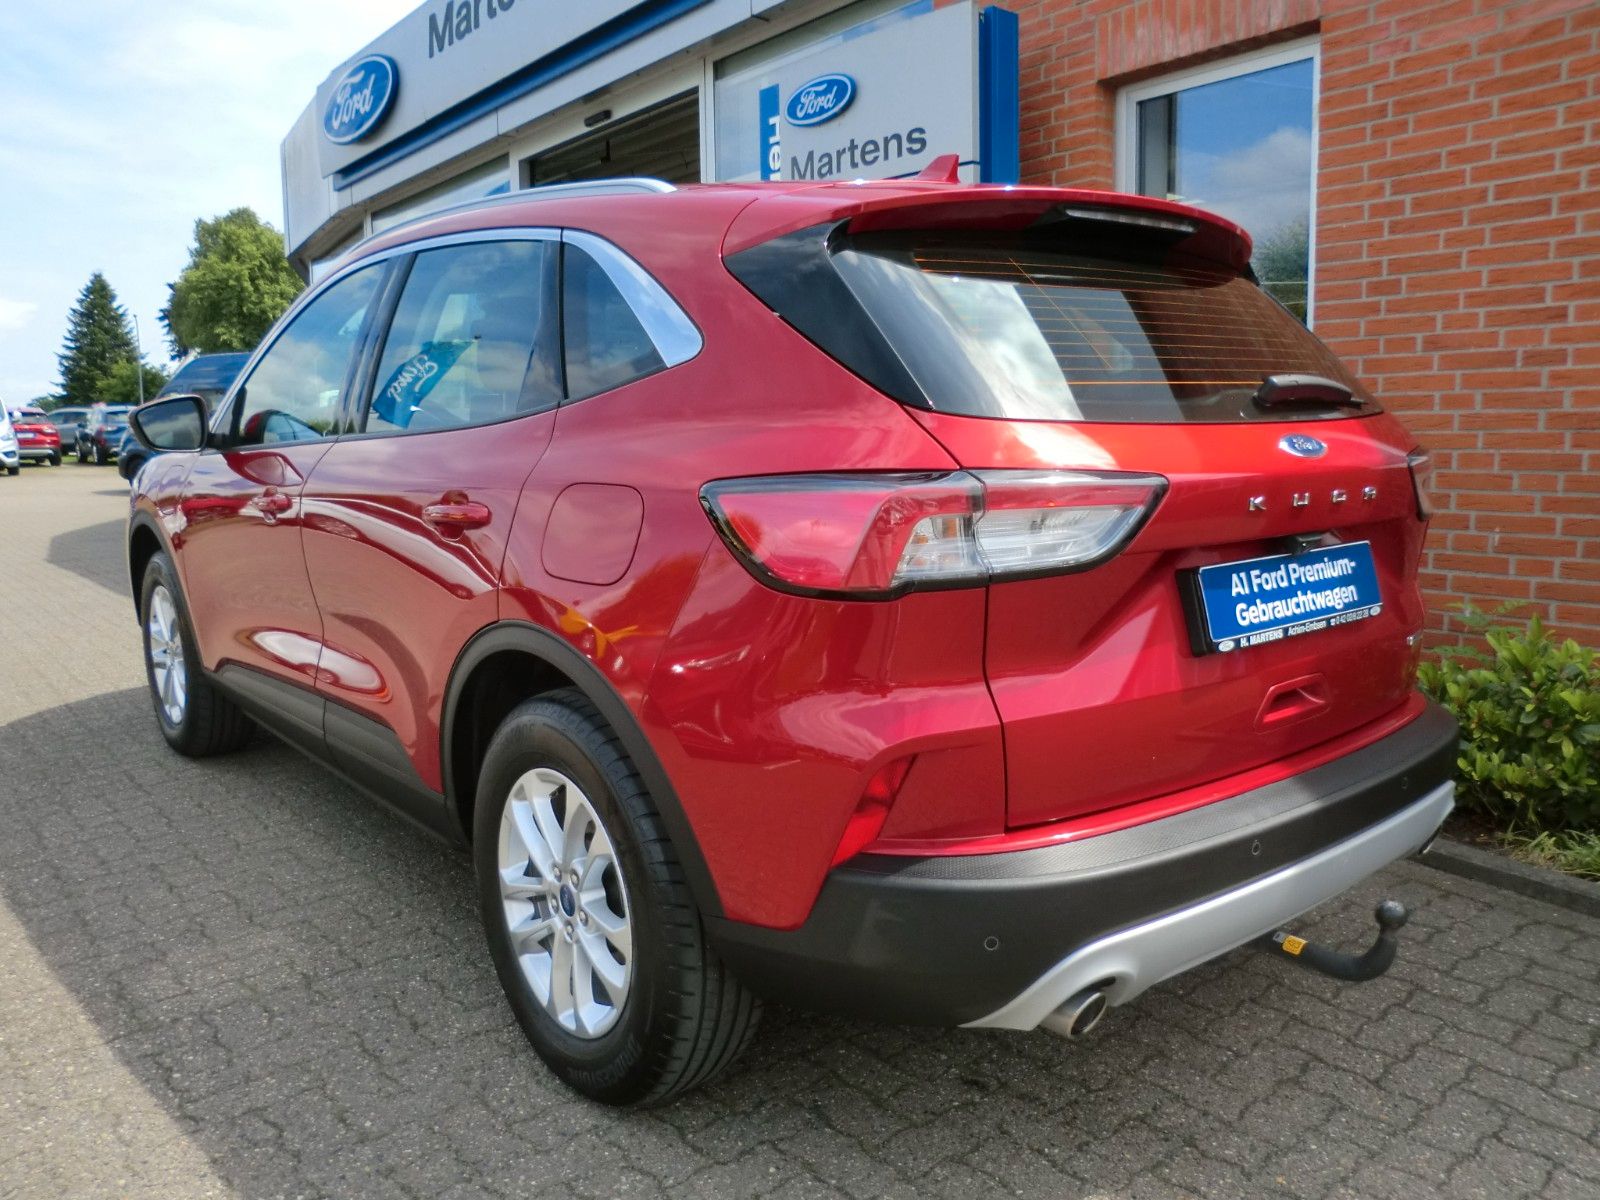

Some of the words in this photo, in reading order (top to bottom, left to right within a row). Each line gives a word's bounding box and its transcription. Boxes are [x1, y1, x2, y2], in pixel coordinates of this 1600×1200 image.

[428, 0, 515, 59] Mar
[332, 70, 375, 130] Ford
[796, 84, 837, 119] Ford
[790, 127, 927, 180] Martens
[387, 354, 438, 402] Ford
[1249, 486, 1377, 511] KUGA
[1231, 570, 1250, 597] A1
[1250, 564, 1289, 593] Ford
[1288, 557, 1356, 586] Premium-
[1236, 584, 1358, 627] Gebrauchtwagen
[1240, 637, 1250, 648] H.
[1249, 628, 1284, 646] MARTENS
[567, 1033, 642, 1086] BRIDGESTONE
